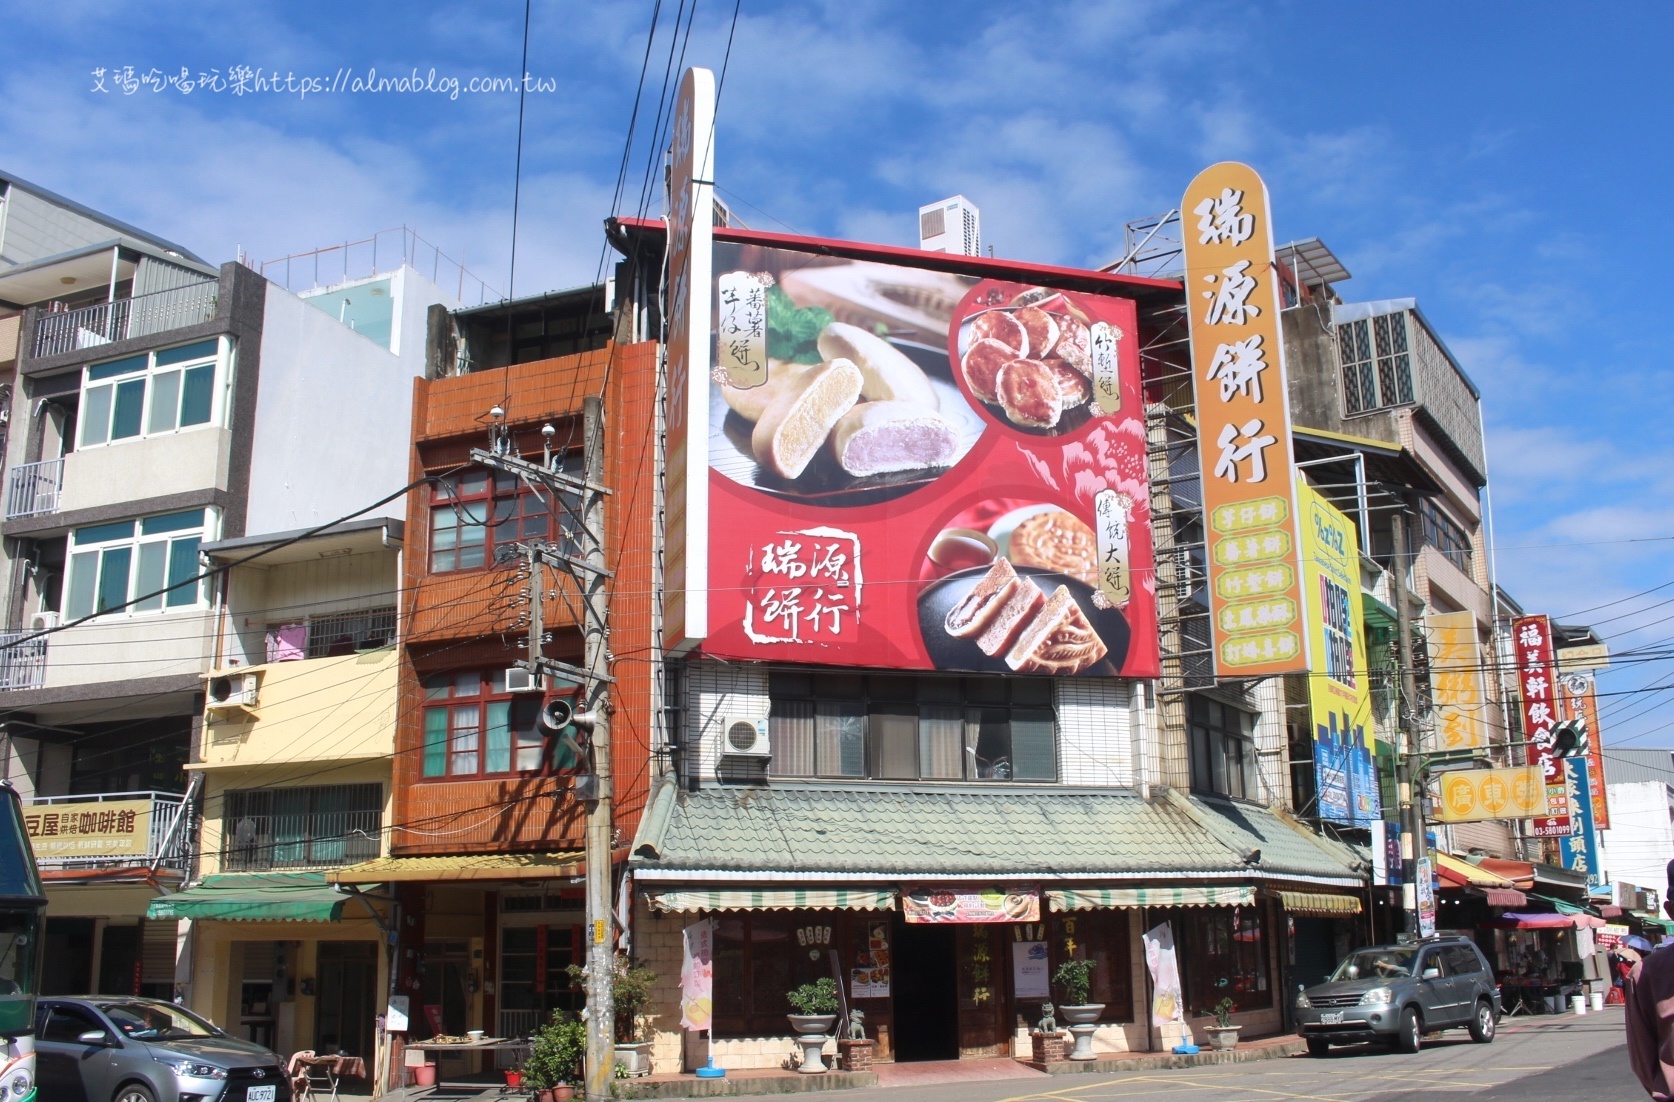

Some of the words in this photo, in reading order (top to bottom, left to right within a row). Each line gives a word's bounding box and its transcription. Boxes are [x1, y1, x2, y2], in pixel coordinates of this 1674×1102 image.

[1193, 187, 1279, 484] 瑞源餅行
[761, 539, 849, 579] 瑞源
[1097, 499, 1130, 596] 傳統大餅
[760, 587, 849, 638] 餅行
[1519, 623, 1557, 776] 福美軒飲食店
[1452, 779, 1538, 808] 廣東粥
[25, 813, 59, 837] 豆屋
[79, 808, 136, 835] 咖啡館
[61, 813, 78, 823] 自家
[1534, 826, 1570, 836] 03-5801099
